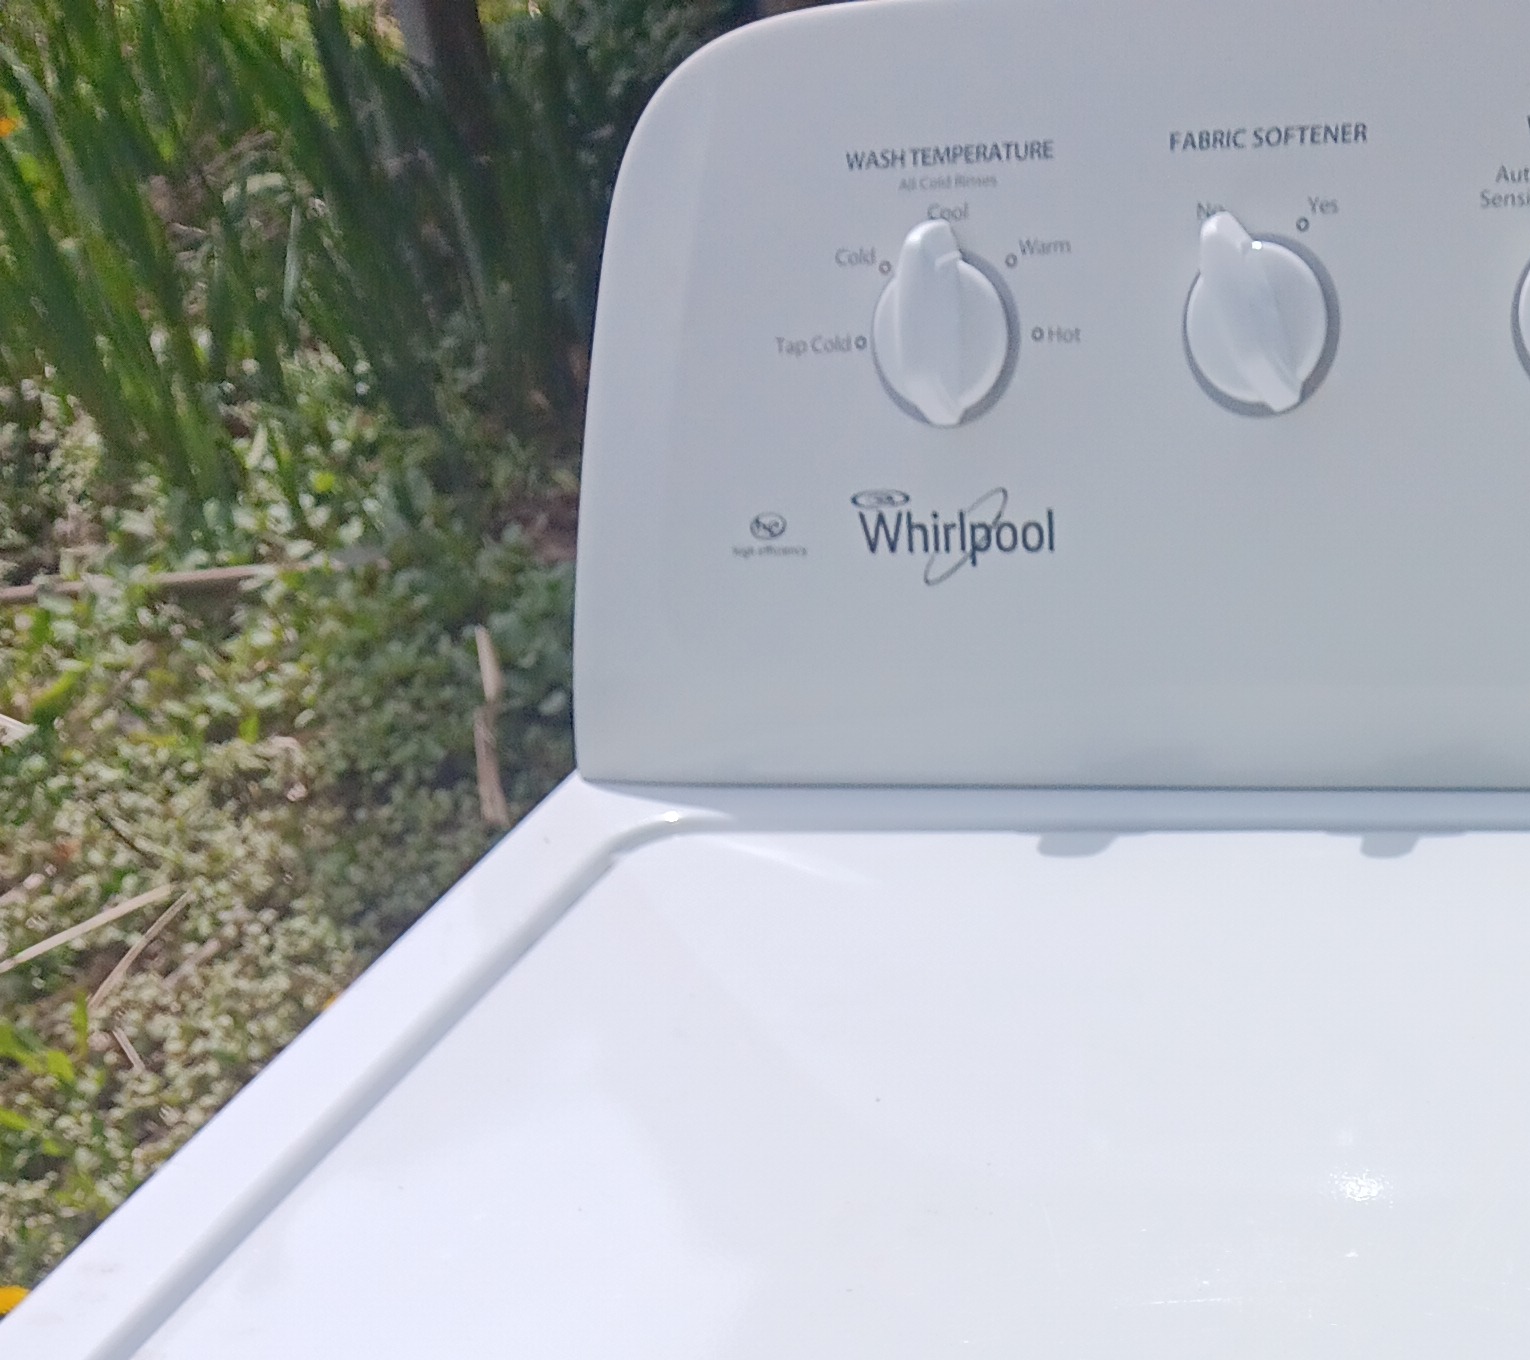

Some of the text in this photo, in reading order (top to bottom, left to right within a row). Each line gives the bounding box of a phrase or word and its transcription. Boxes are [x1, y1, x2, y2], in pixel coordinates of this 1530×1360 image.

[1169, 121, 1368, 151] FABRIC SOFTENER
[846, 138, 1054, 171] WASH TEMPERATURE
[927, 202, 969, 221] Cool
[1308, 196, 1339, 214] Yes
[835, 247, 875, 268] Cold
[1018, 236, 1072, 258] Warm
[1047, 325, 1081, 344] Hot
[776, 334, 852, 358] Tap Cold
[858, 507, 1055, 567] Whirlpool
